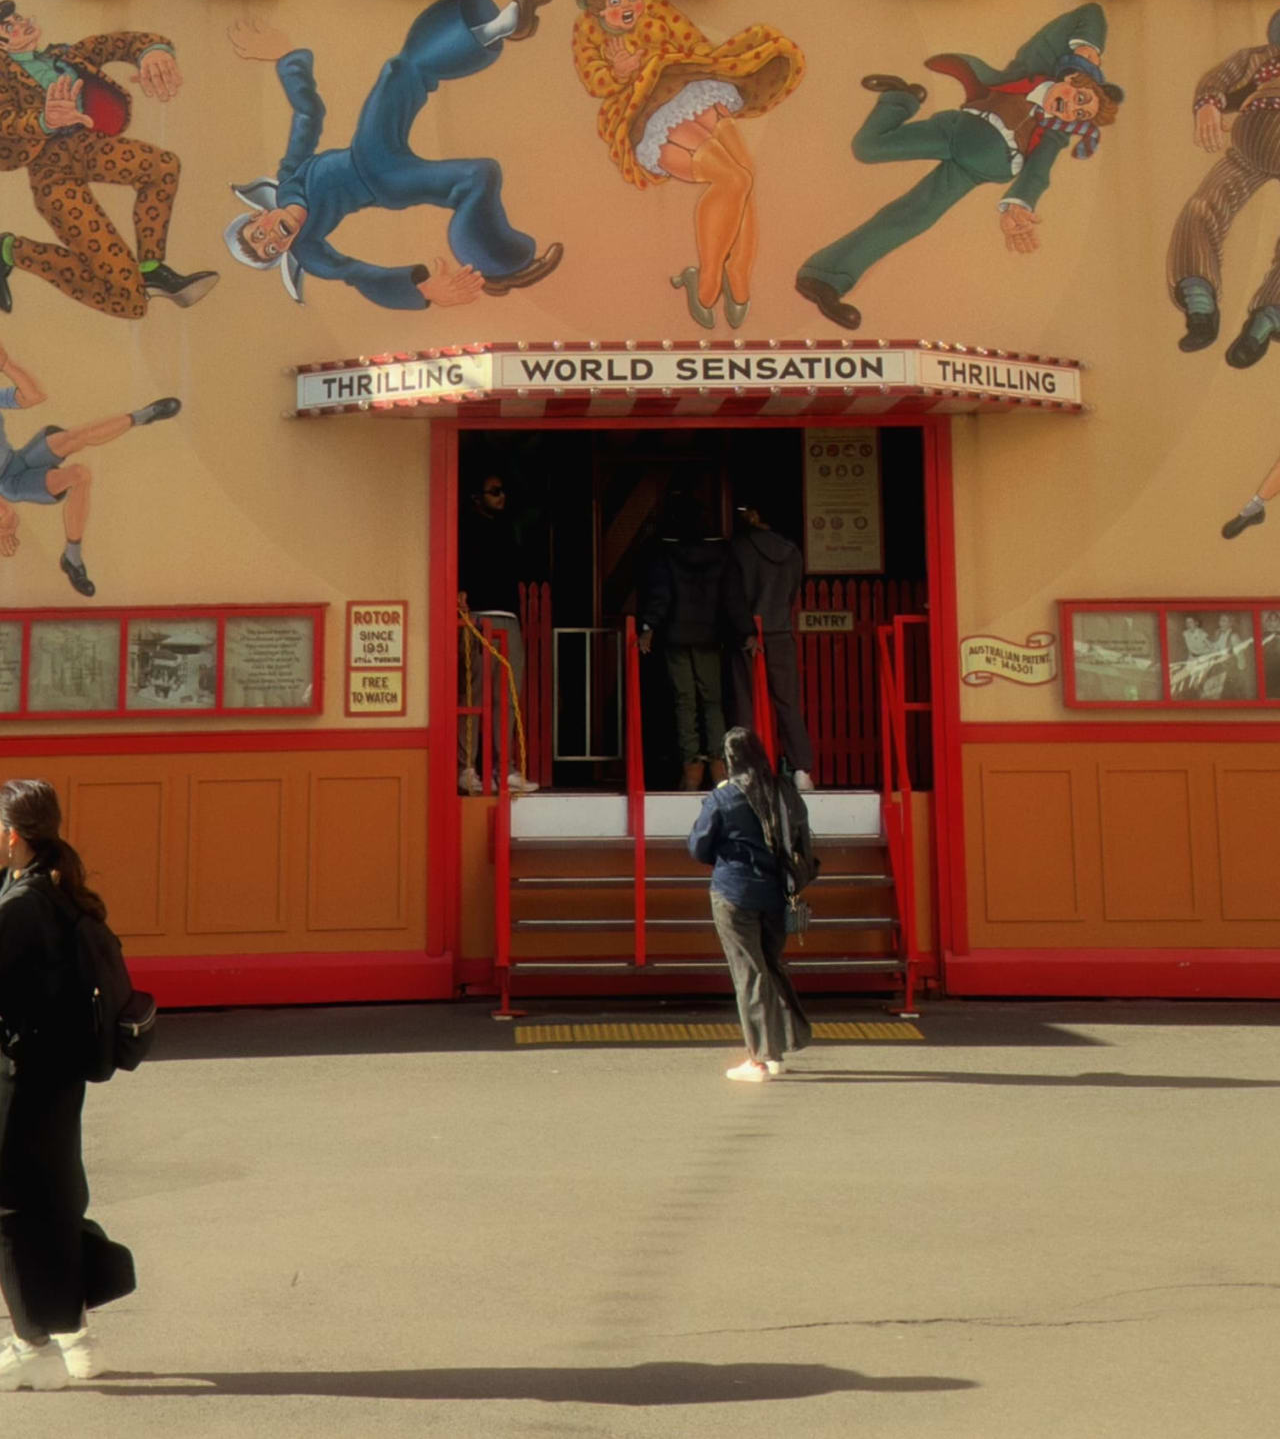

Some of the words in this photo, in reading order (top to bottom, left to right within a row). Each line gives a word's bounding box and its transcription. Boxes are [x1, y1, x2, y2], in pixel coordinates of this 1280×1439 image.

[322, 364, 464, 399] THRILLING
[521, 358, 654, 382] WORLD
[676, 356, 885, 381] SENSATION
[937, 360, 1056, 394] THRILLING
[354, 610, 401, 624] ROTOR
[806, 615, 847, 626] ENTRY
[360, 630, 393, 641] SINCE
[363, 643, 389, 654] 1951
[968, 645, 1020, 662] AUSTRALIAN
[362, 677, 389, 688] FREE
[352, 691, 363, 703] TO
[365, 691, 398, 704] WATCH
